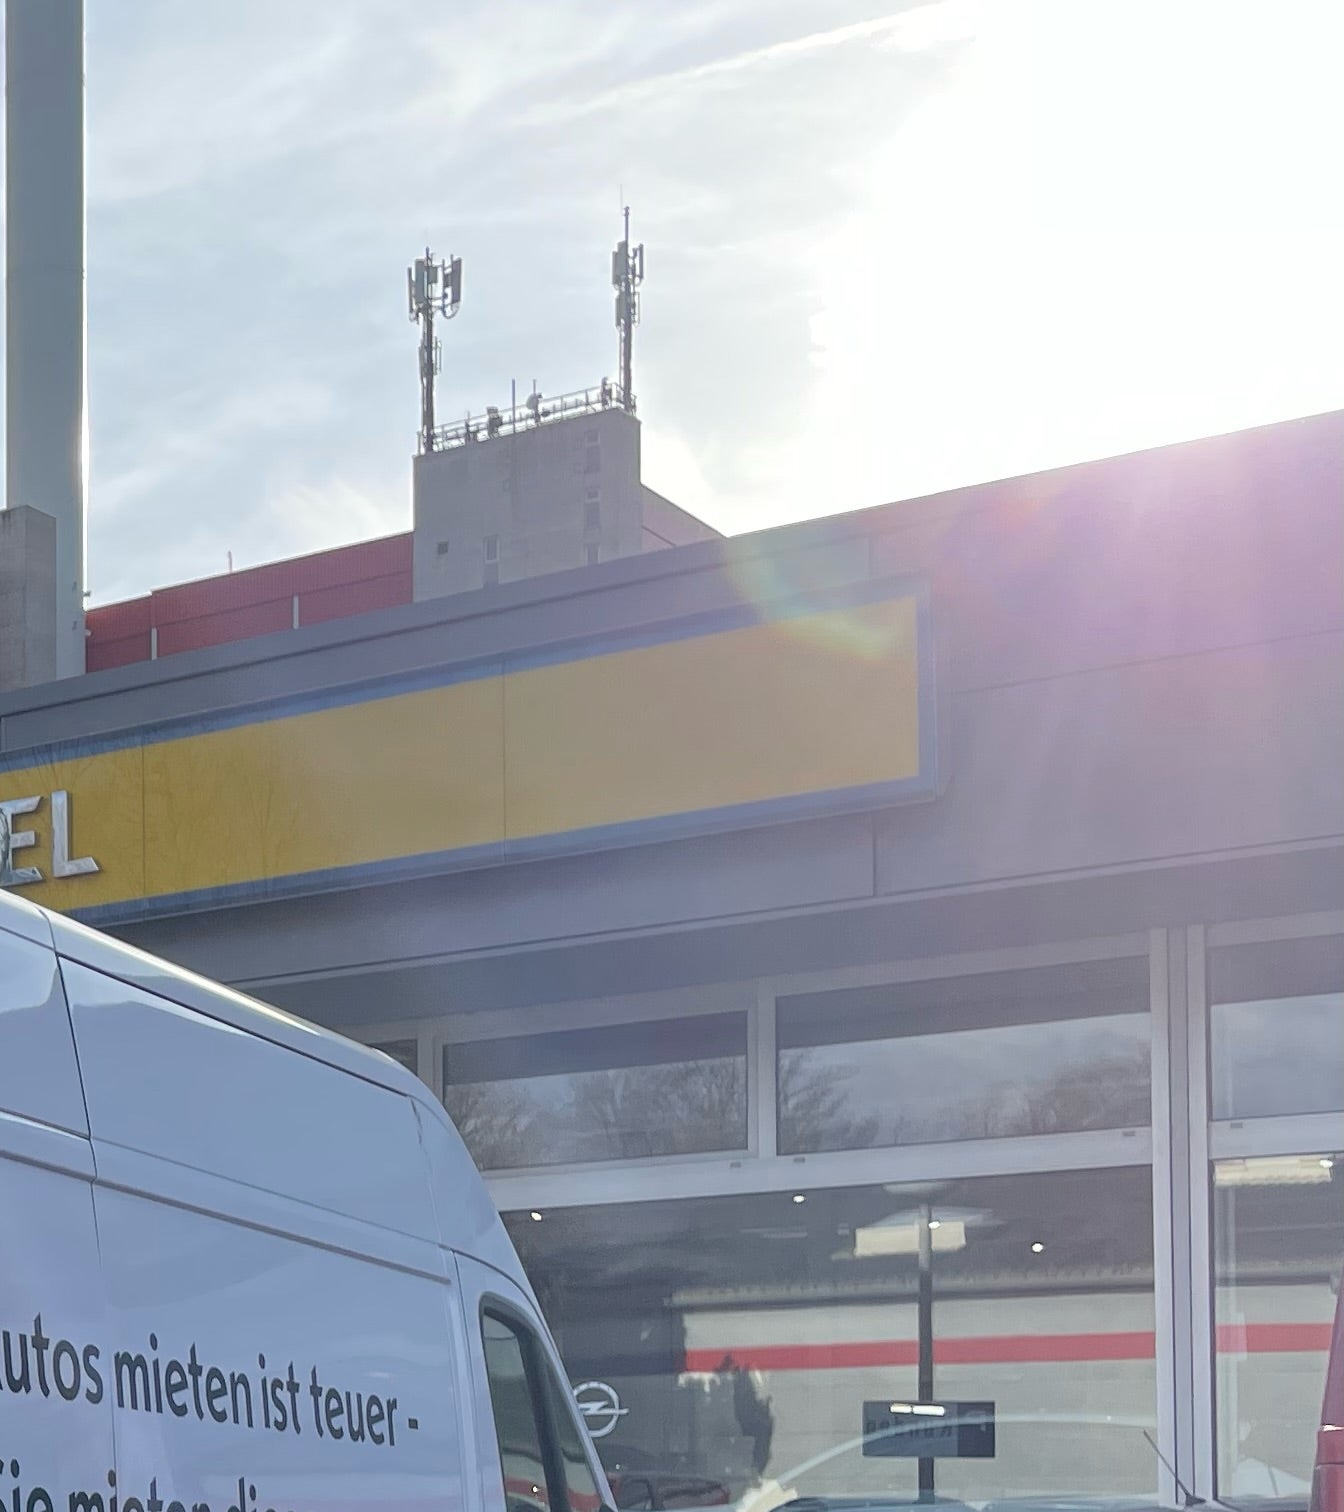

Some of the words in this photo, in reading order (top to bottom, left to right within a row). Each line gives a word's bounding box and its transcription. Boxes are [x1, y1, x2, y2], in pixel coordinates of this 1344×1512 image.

[114, 1333, 255, 1429] mieten
[258, 1353, 302, 1435] ist
[309, 1366, 398, 1447] teuer
